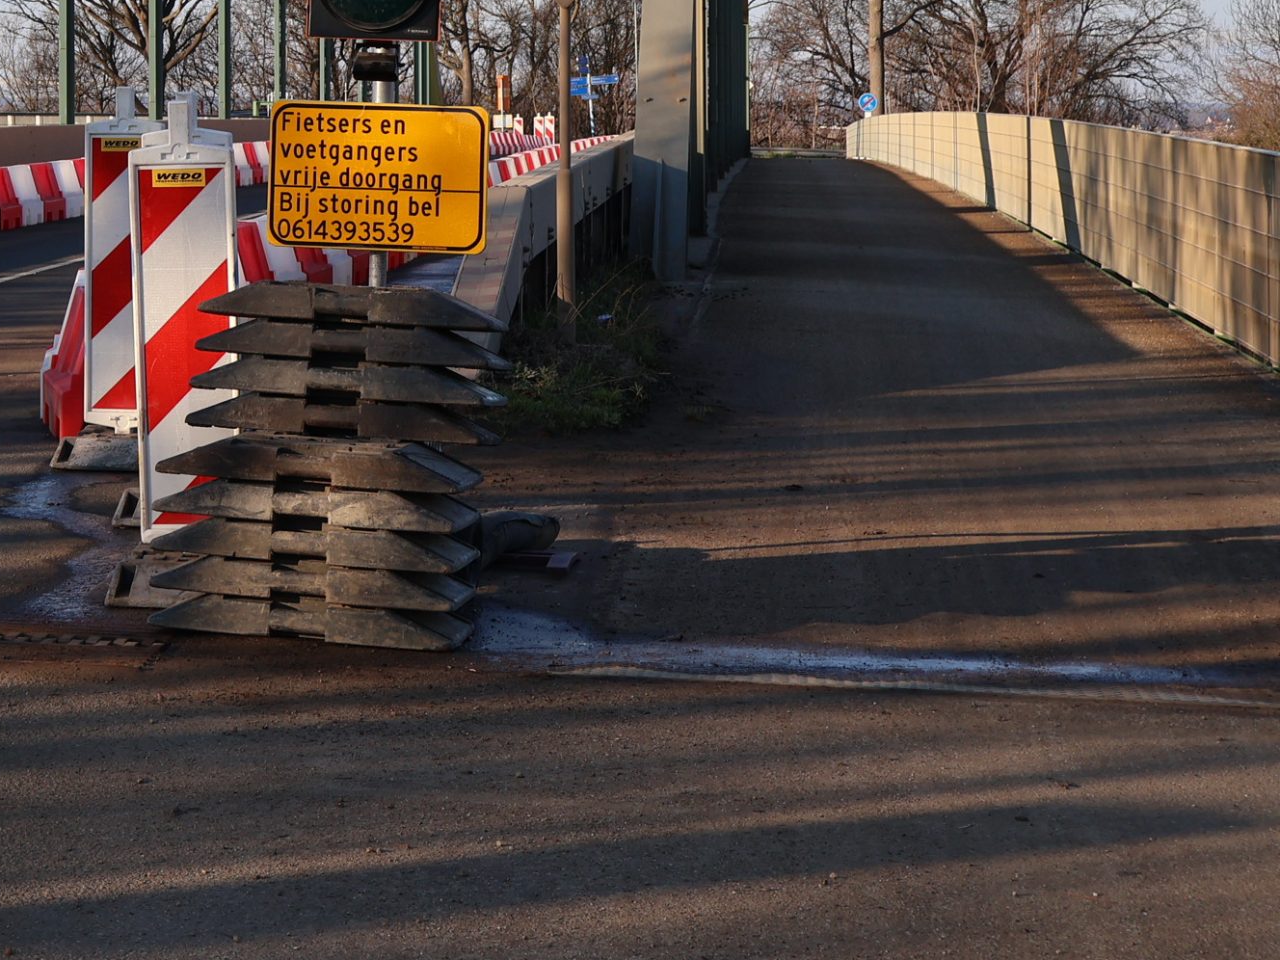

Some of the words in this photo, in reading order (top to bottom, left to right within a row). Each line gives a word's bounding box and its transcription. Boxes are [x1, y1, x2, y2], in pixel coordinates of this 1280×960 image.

[282, 111, 372, 134] Fietsers
[380, 118, 406, 135] en
[280, 140, 419, 167] voetgangers
[157, 172, 202, 180] WEDO
[279, 166, 331, 192] vrije
[339, 167, 442, 195] doorgang
[279, 192, 310, 218] Bij
[318, 194, 399, 221] storing
[408, 195, 440, 217] bel
[277, 218, 415, 243] 0614393539
